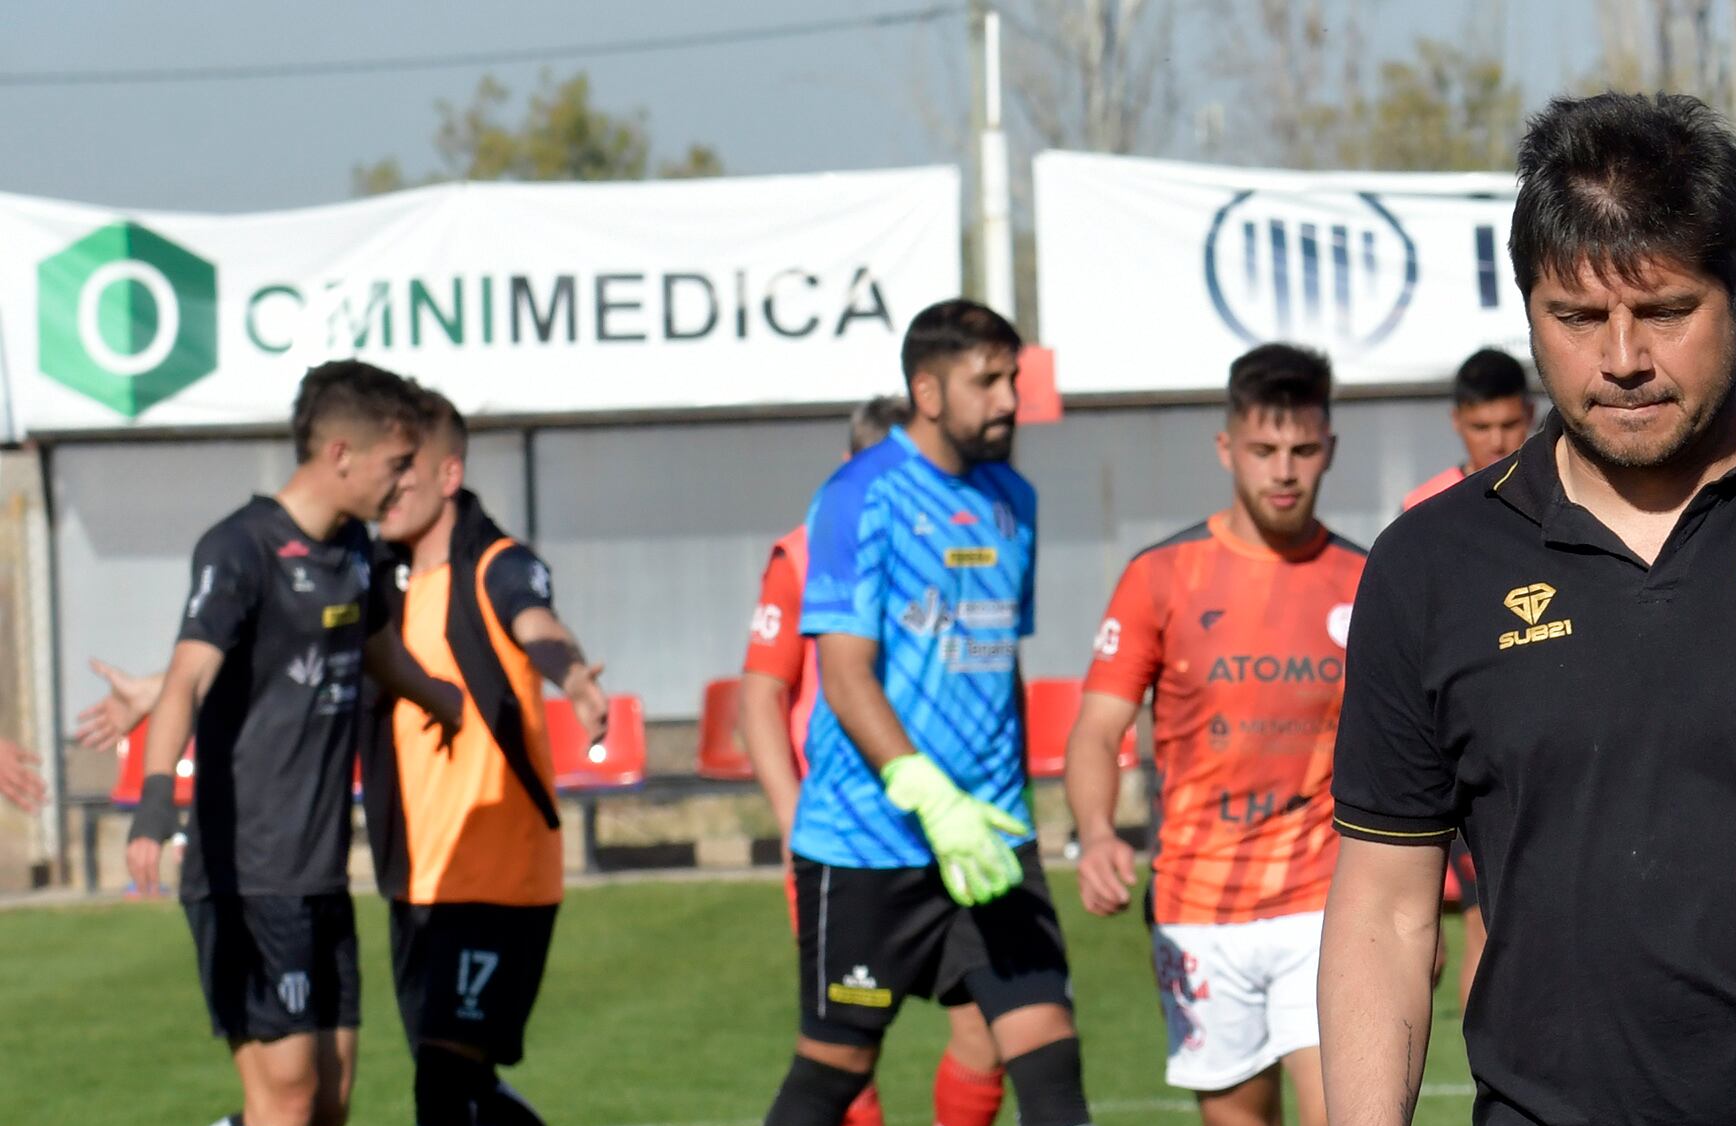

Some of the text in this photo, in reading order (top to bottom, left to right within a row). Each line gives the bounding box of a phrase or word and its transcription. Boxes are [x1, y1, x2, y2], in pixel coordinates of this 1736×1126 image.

[244, 264, 894, 355] OMNIMEDICA
[1498, 618, 1573, 650] SUB21
[1206, 654, 1343, 684] ATOMO
[456, 949, 499, 997] 17
